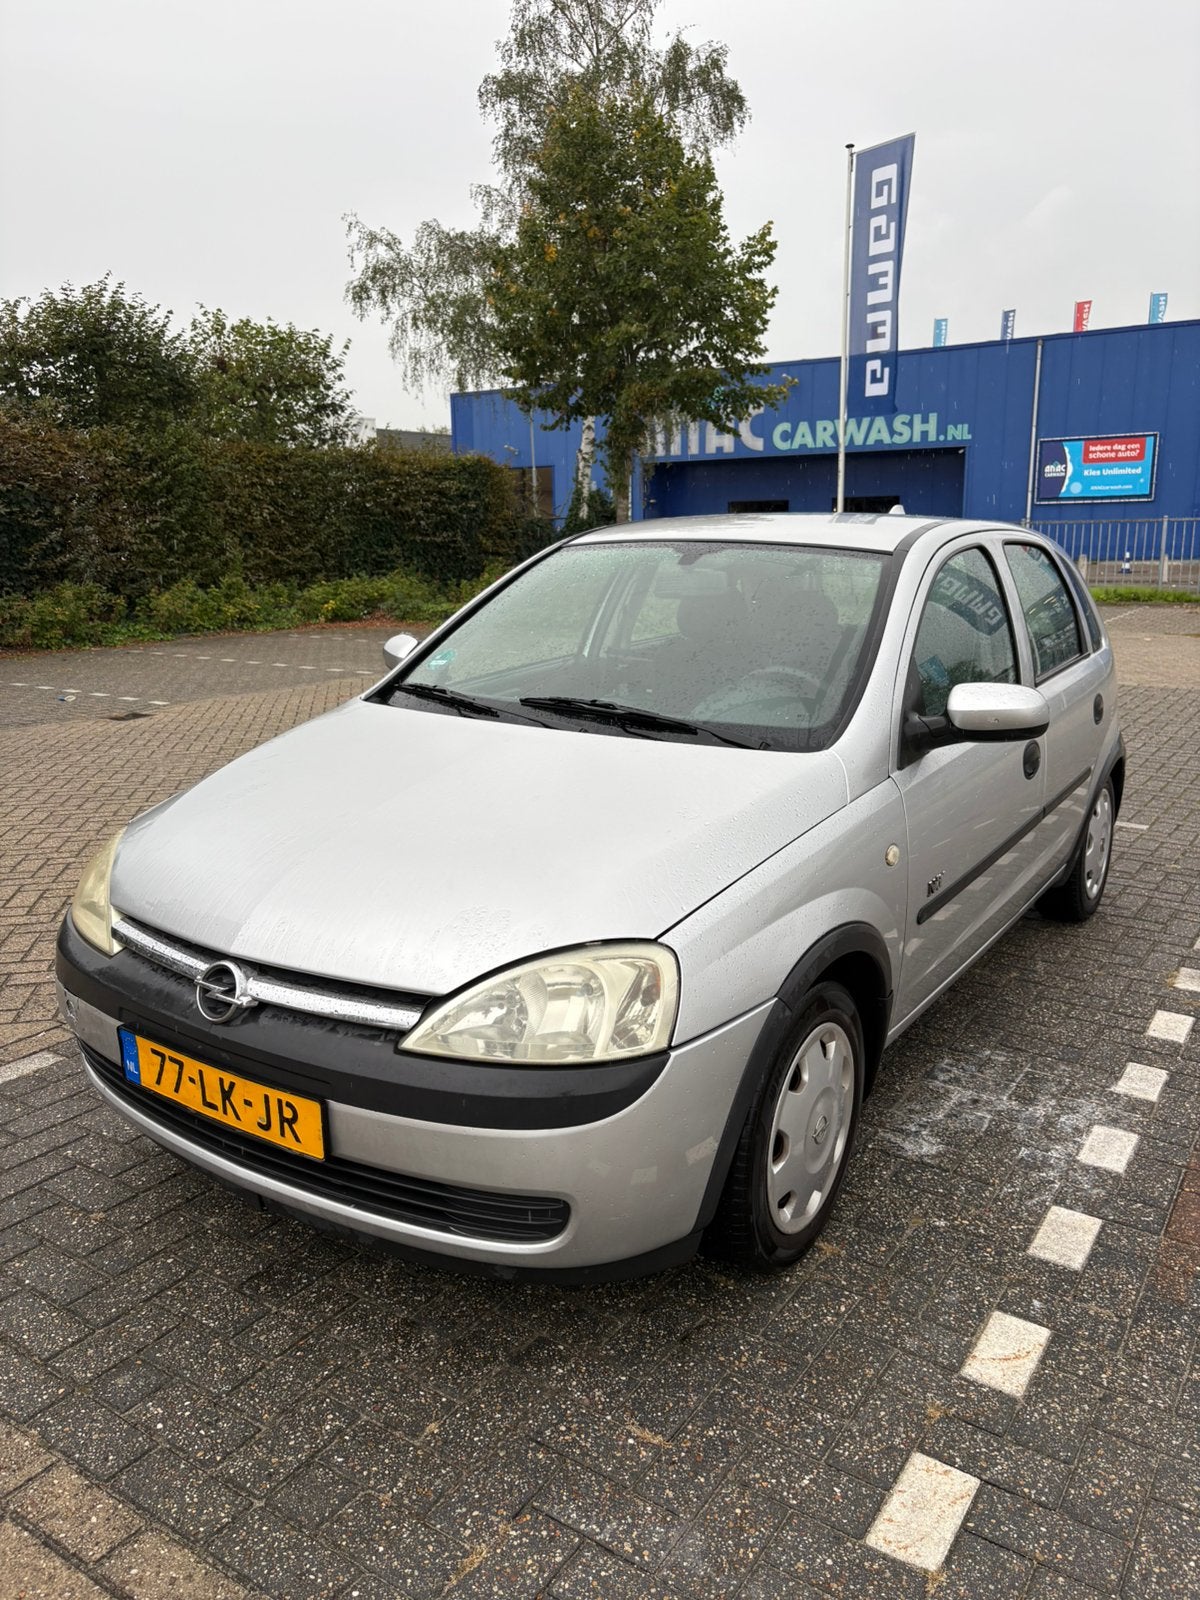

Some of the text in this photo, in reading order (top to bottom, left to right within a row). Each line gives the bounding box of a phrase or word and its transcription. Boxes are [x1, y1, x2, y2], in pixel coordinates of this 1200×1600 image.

[1113, 443, 1126, 452] dag
[1088, 449, 1140, 459] schone auto?
[1083, 466, 1142, 477] Kies Unlimited
[126, 1059, 139, 1075] NL
[150, 1047, 302, 1144] 77-LK-JR
